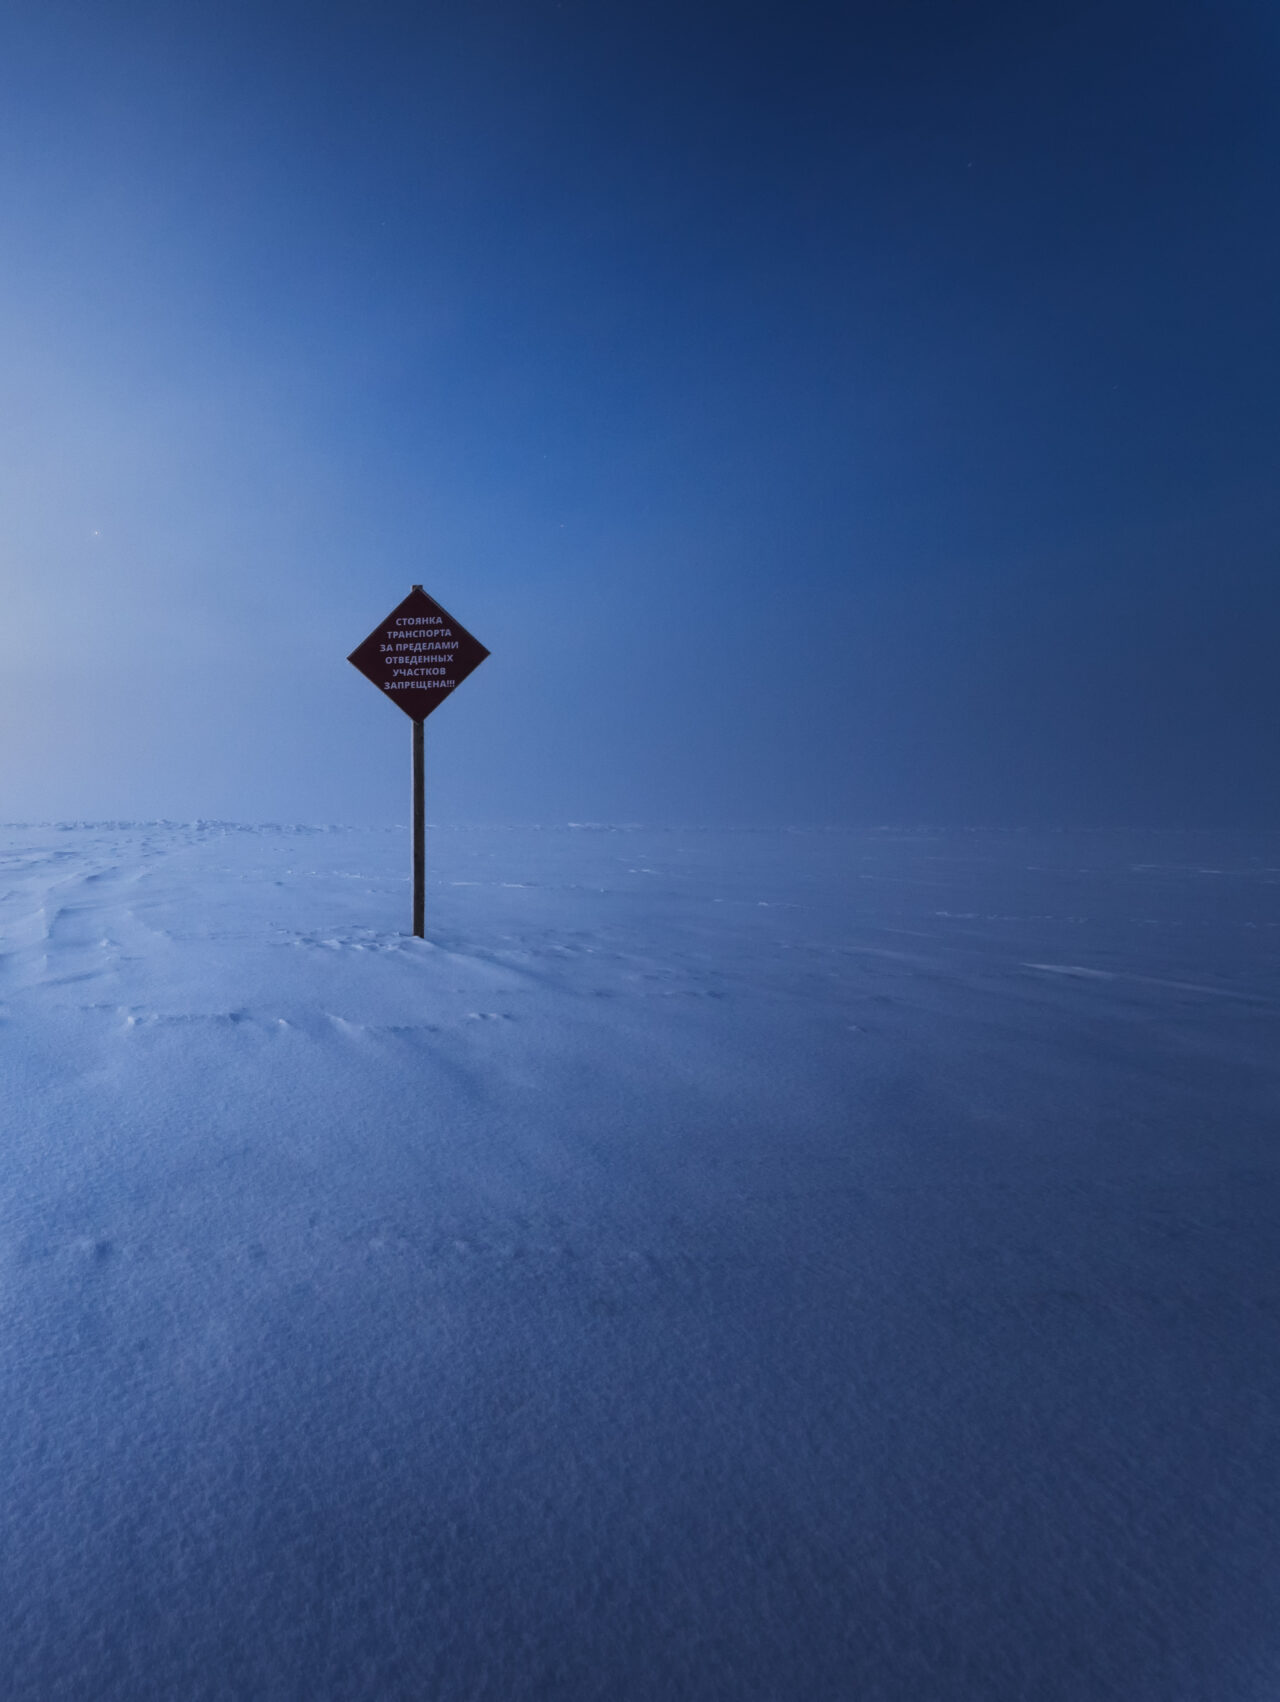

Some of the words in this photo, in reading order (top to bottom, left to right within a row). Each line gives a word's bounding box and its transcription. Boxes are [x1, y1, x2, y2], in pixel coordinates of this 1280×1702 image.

[395, 616, 443, 626] СТОЯНКА
[386, 628, 452, 639] ТРАНСПОРТА
[379, 644, 393, 652] ЗА
[395, 641, 459, 652] ПРЕДЕЛАМИ
[385, 654, 454, 665] ОТВЕДЕННЫХ
[392, 667, 446, 677] УЧАСТКОВ
[384, 679, 455, 690] ЗАПРЕЩЕНА!!!
